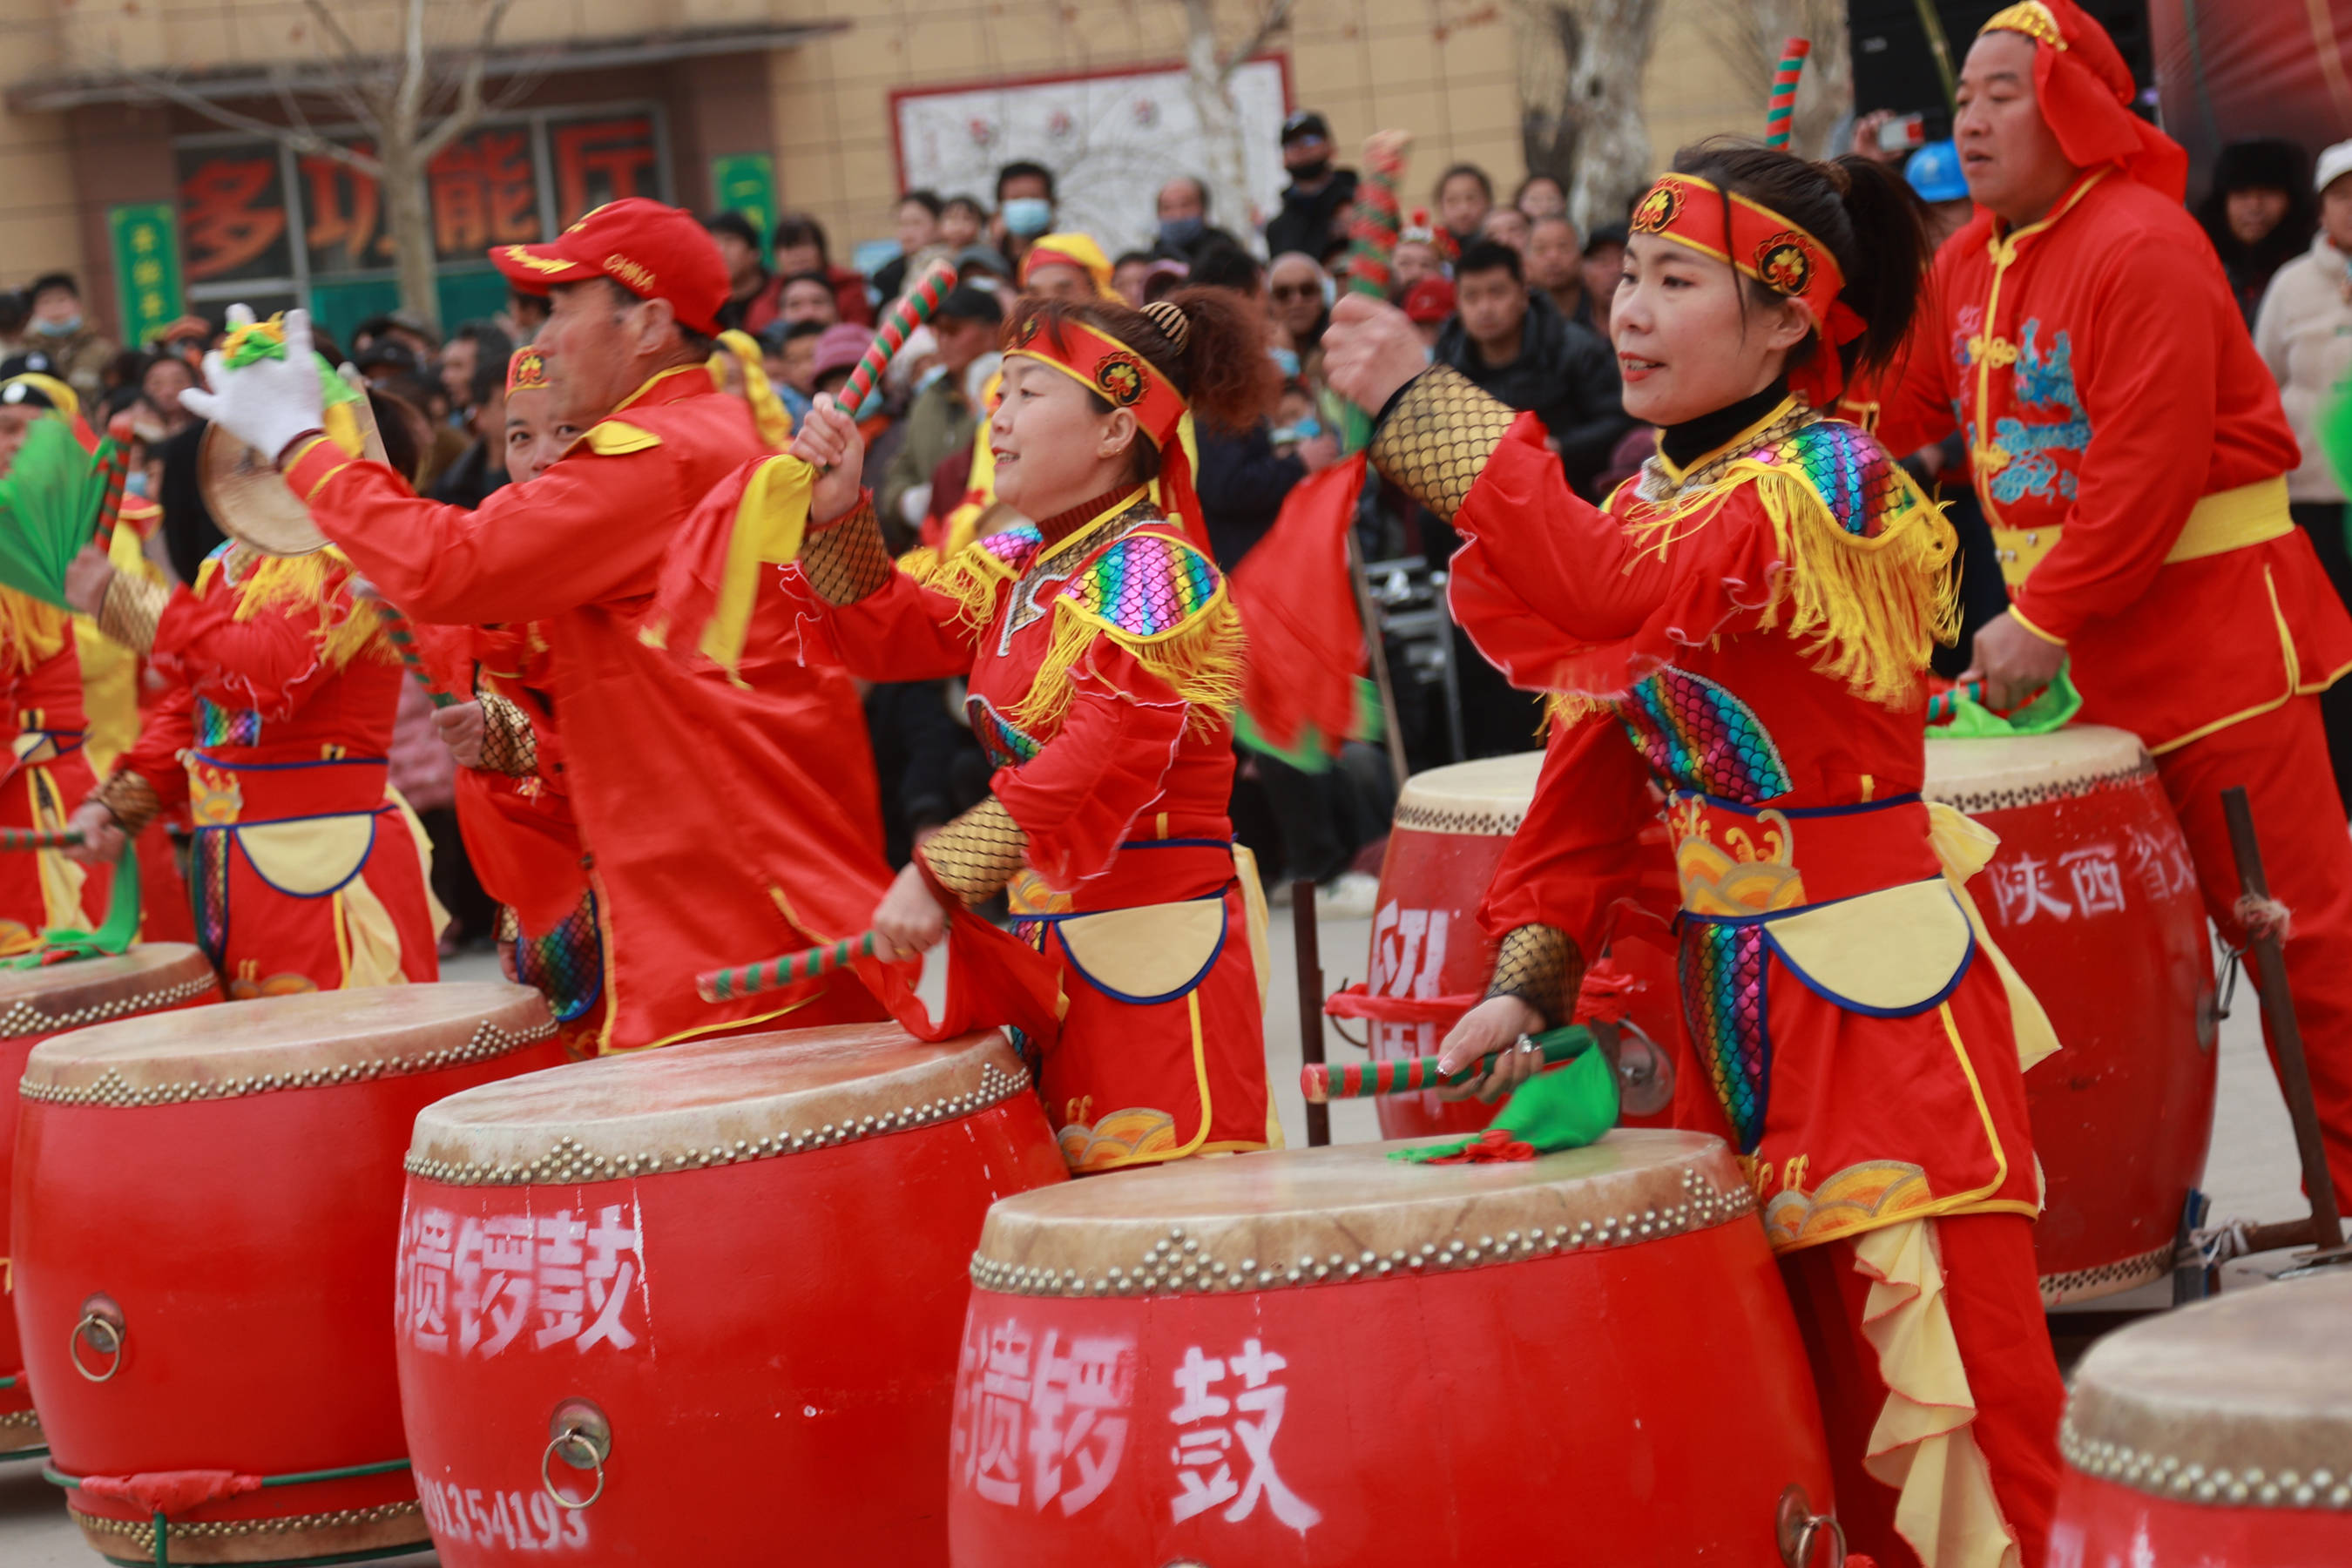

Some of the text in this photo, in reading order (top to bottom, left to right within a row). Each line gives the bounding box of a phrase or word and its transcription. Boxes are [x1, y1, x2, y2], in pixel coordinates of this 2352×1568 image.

[179, 122, 656, 280] 多功能厅
[1985, 828, 2198, 925] 陕西省
[398, 1204, 638, 1358] 遗锣鼓
[952, 1319, 1321, 1535] 遗锣鼓
